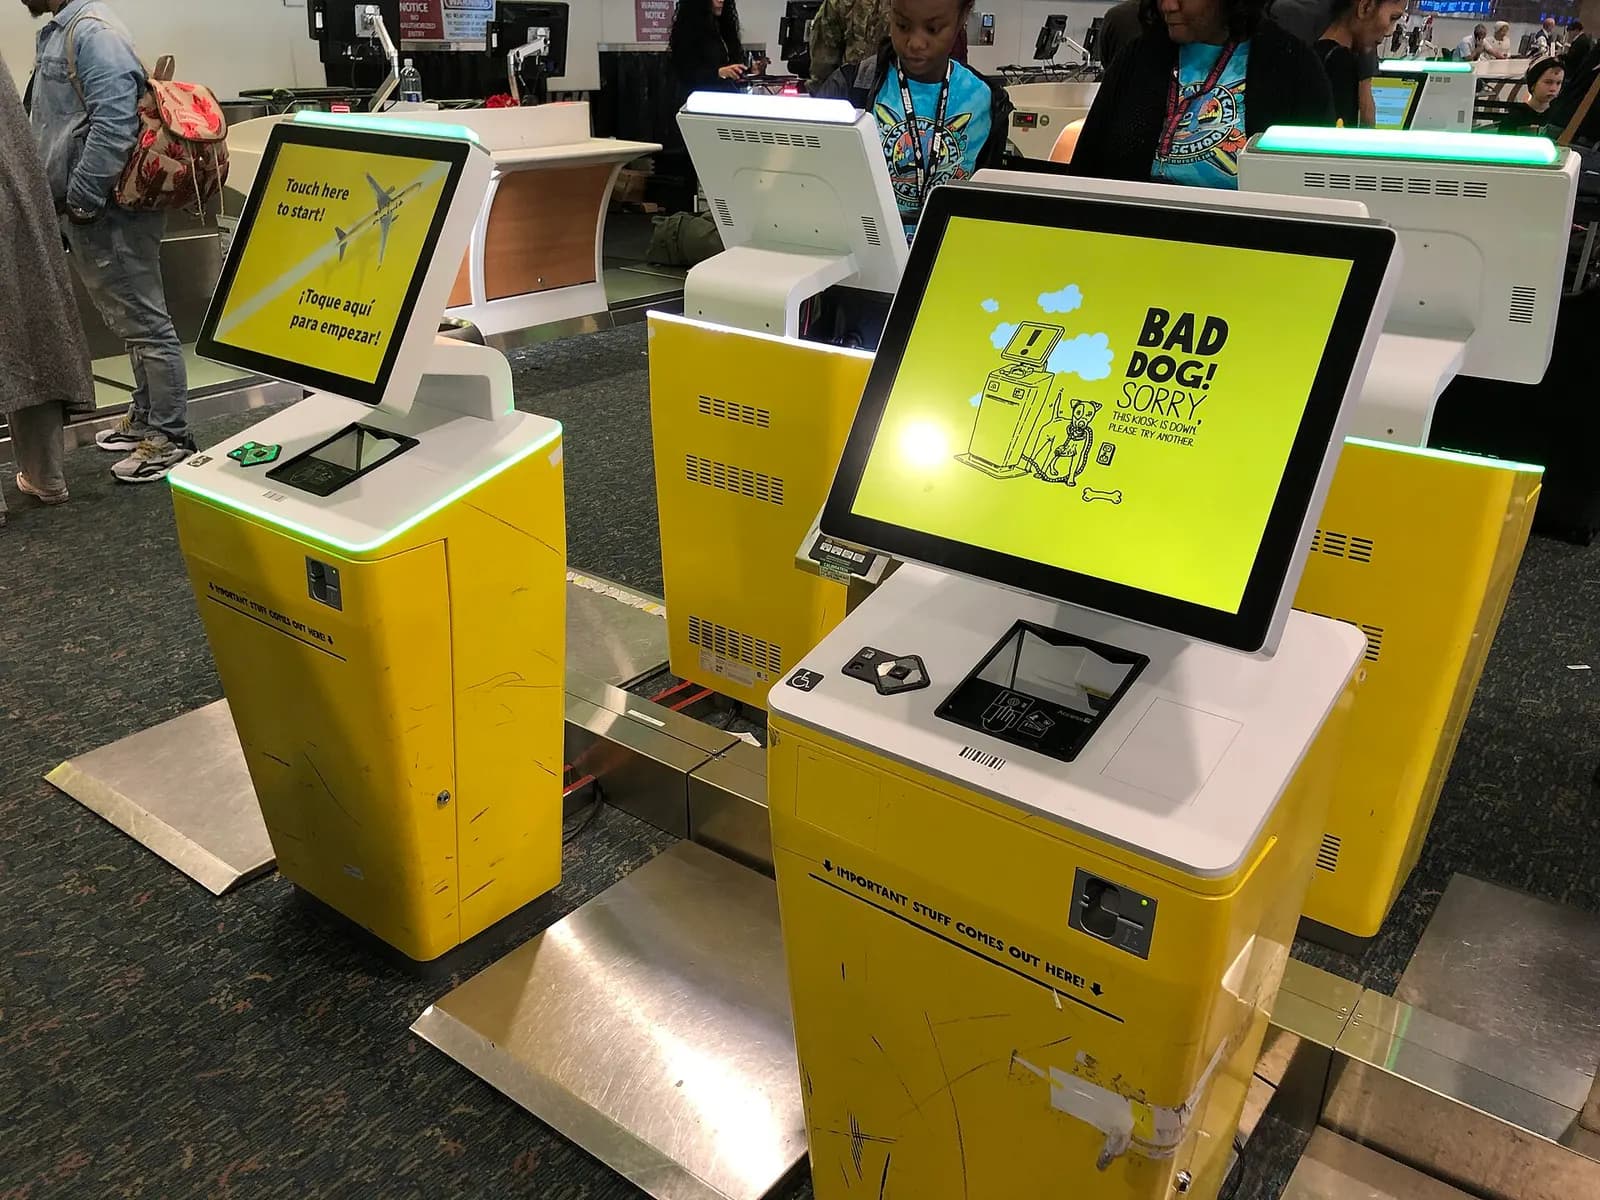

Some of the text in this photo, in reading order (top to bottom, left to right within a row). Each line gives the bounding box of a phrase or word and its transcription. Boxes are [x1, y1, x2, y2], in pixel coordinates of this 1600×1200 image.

[400, 2, 429, 13] NOTICE
[286, 178, 350, 200] Touch here
[277, 202, 325, 222] to start!
[299, 288, 376, 317] ¡Toque aquí
[290, 314, 381, 346] para empezar!
[1137, 307, 1229, 356] BAD
[1126, 350, 1218, 391] DOG!
[1117, 382, 1208, 425] SORRY,
[1108, 423, 1137, 436] PLEASE
[1140, 428, 1155, 439] TRY
[1112, 411, 1131, 423] THIS
[1131, 415, 1159, 428] KIOSK
[1160, 420, 1169, 430] IS
[214, 585, 326, 642] IMPORTANT STUFF COMES OUT HERE!
[837, 866, 1086, 989] IMPORTANT STUFF COMES OUT HERE!
